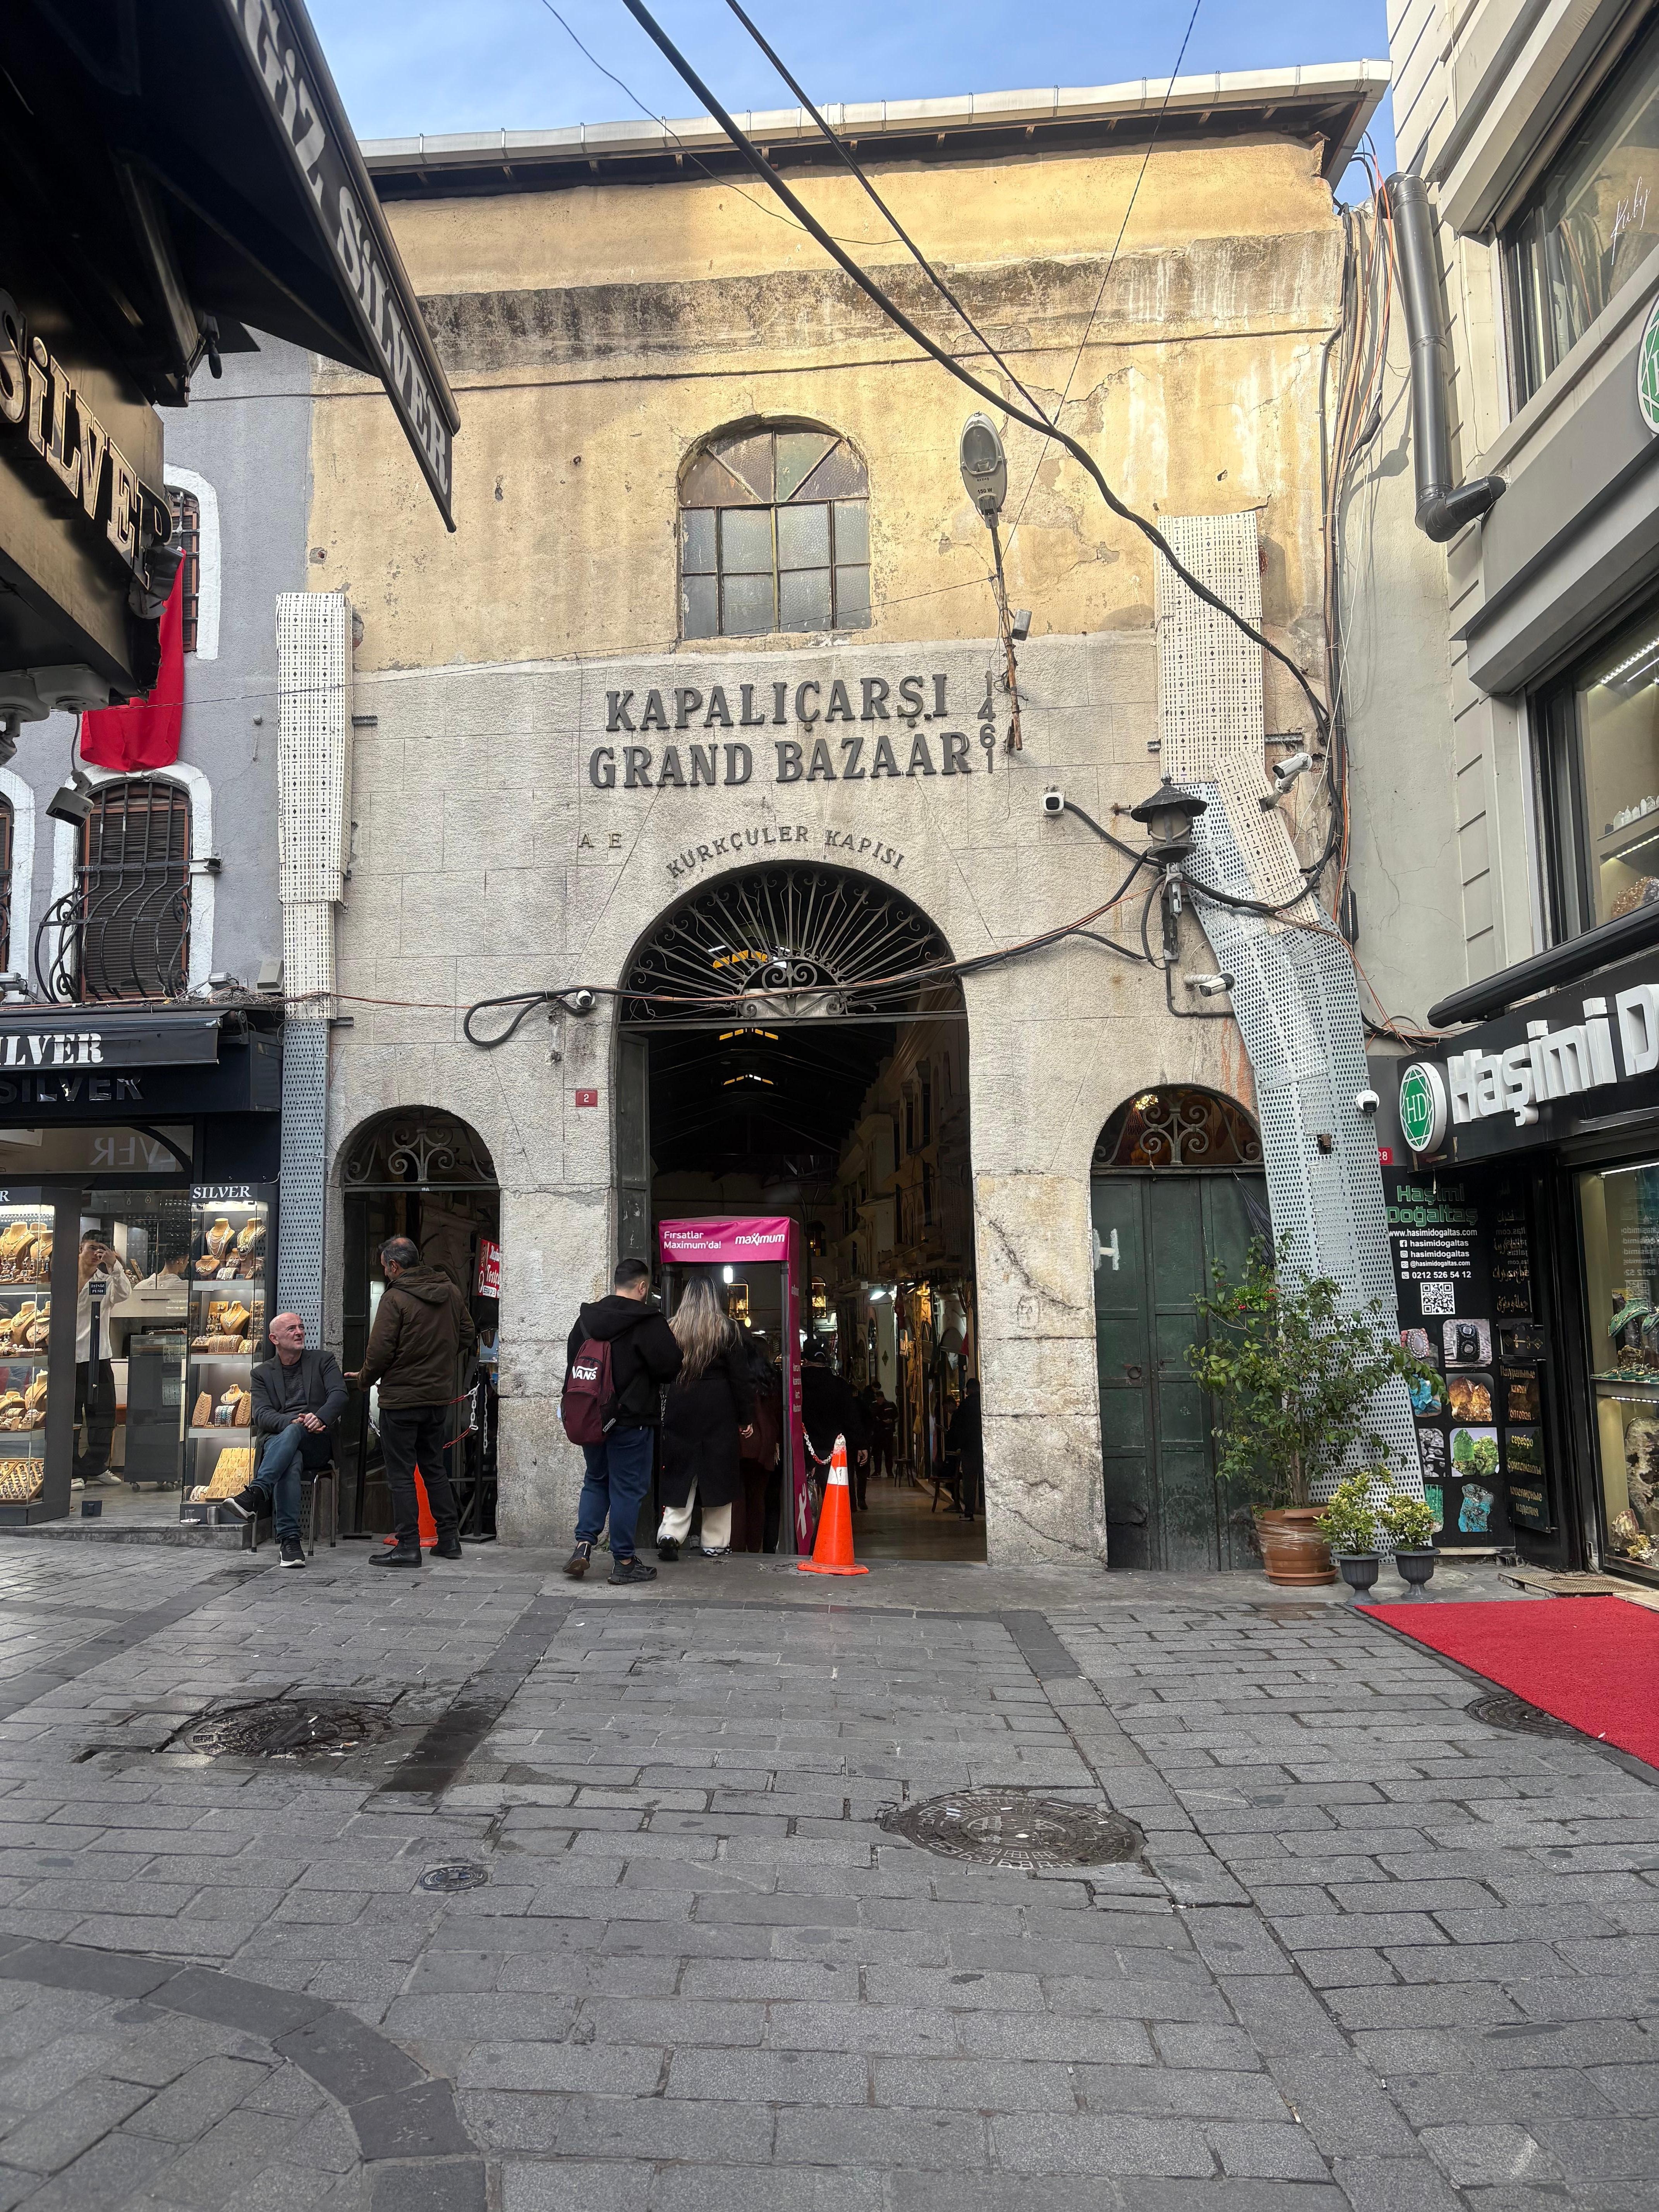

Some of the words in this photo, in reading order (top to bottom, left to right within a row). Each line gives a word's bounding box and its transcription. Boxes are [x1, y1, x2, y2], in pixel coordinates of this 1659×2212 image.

[589, 743, 752, 788] GRAND
[775, 732, 971, 782] BAZAAR
[0, 1033, 103, 1065] LVER
[1447, 997, 1617, 1126] Haşimi
[584, 1094, 589, 1103] 2
[1405, 1092, 1427, 1124] HD
[193, 1185, 252, 1199] SILVER
[1386, 1204, 1479, 1227] Doğaltaş
[664, 1231, 704, 1239] Fırsatlar
[1388, 1228, 1477, 1238] www.hasimidogaltas.com
[1410, 1240, 1469, 1248] hasimidogaltas
[1410, 1250, 1470, 1259] hasimidogaltas
[572, 1366, 598, 1380] VANS
[1511, 1435, 1533, 1449] серебро
